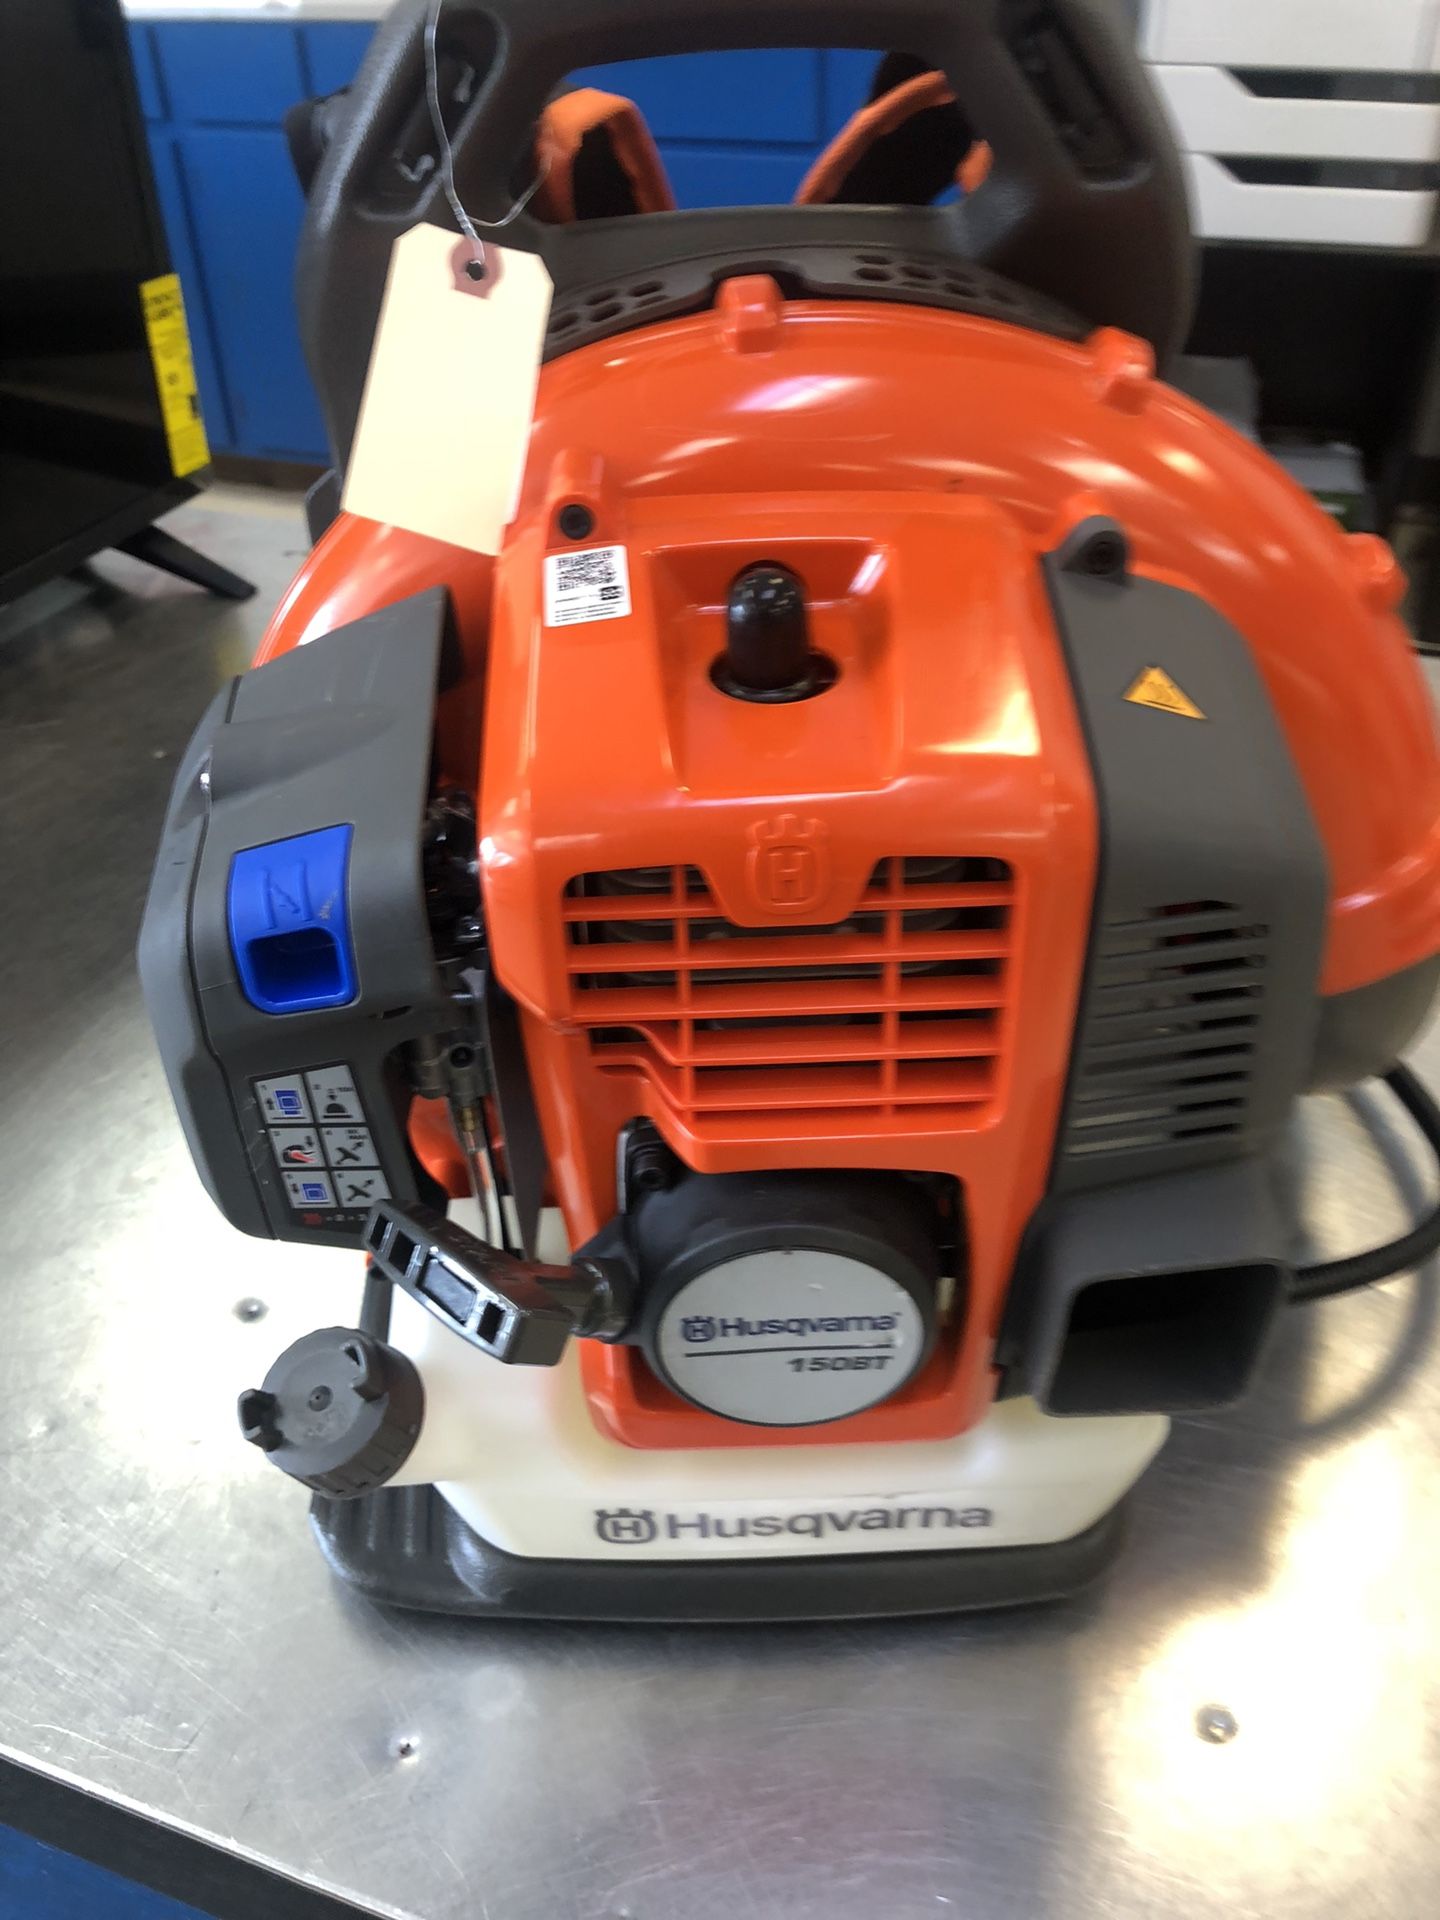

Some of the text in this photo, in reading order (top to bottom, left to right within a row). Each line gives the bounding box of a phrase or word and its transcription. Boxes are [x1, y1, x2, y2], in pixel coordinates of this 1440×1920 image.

[719, 1314, 898, 1337] Husqvarna
[788, 1355, 894, 1372] 150BT
[666, 1505, 993, 1539] Husqvarna
